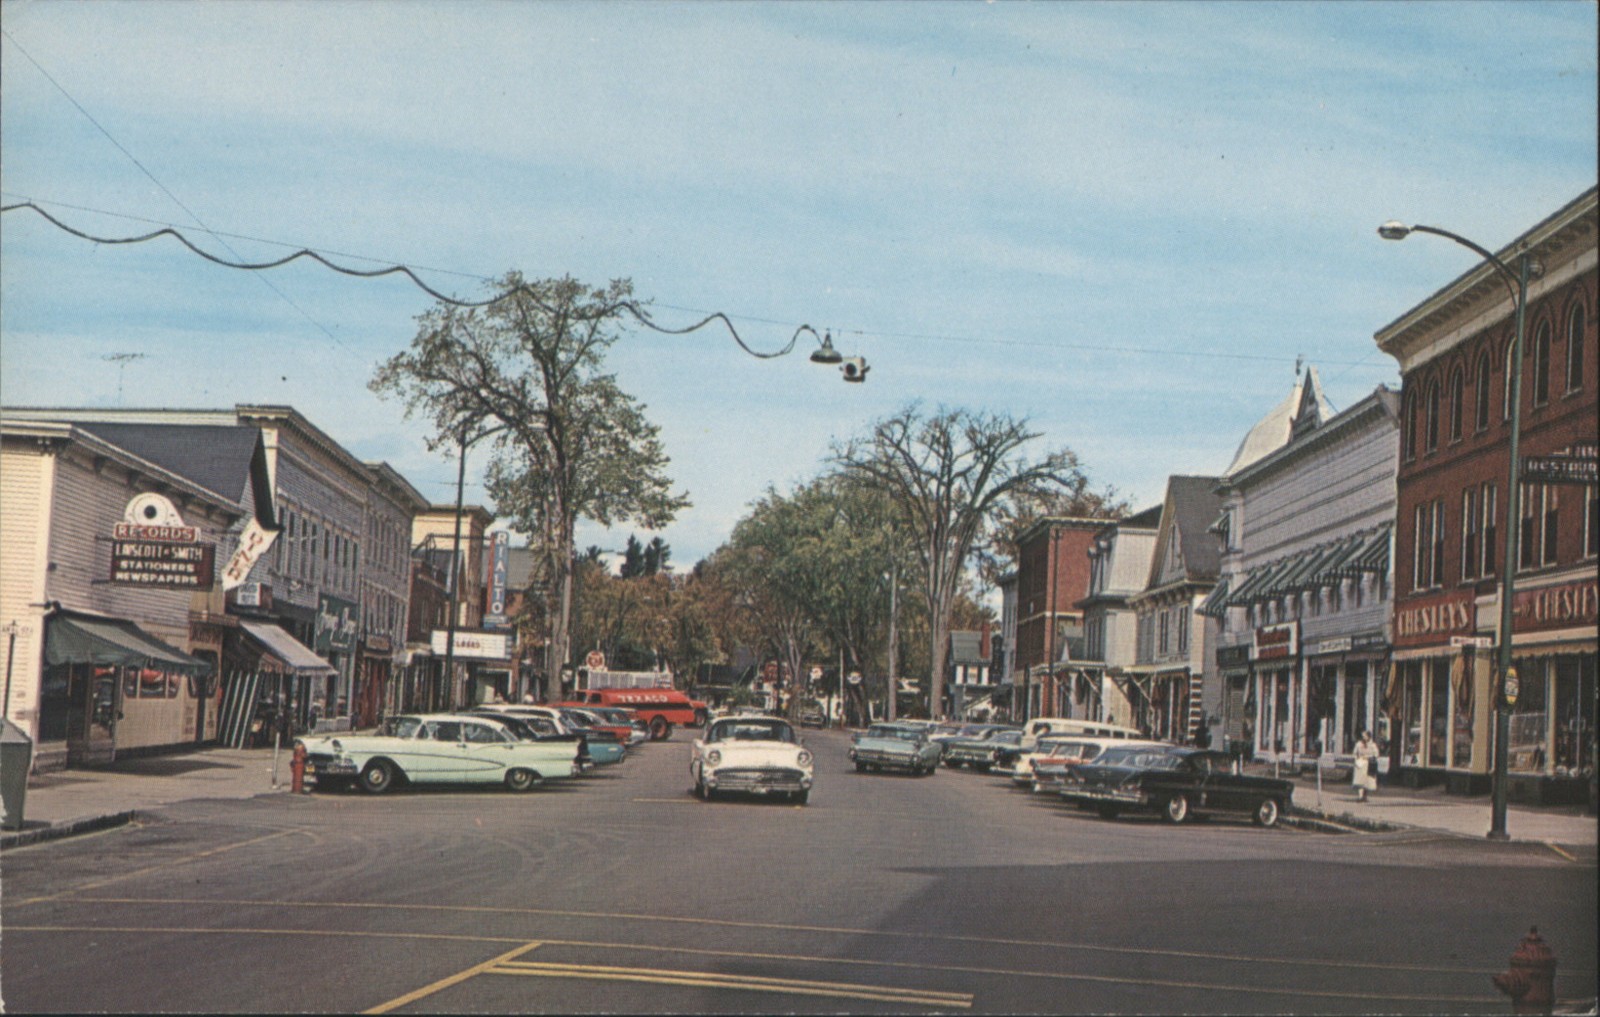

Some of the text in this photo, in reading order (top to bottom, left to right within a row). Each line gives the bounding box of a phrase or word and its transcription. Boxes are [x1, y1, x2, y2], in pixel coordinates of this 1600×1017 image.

[118, 525, 194, 540] RECORDS
[120, 560, 195, 573] STATIONERS
[491, 532, 508, 614] RIALTO
[115, 571, 199, 585] NEWSPAPERS
[1398, 600, 1469, 636] CHESLEY'S
[617, 694, 669, 704] TEXACO
